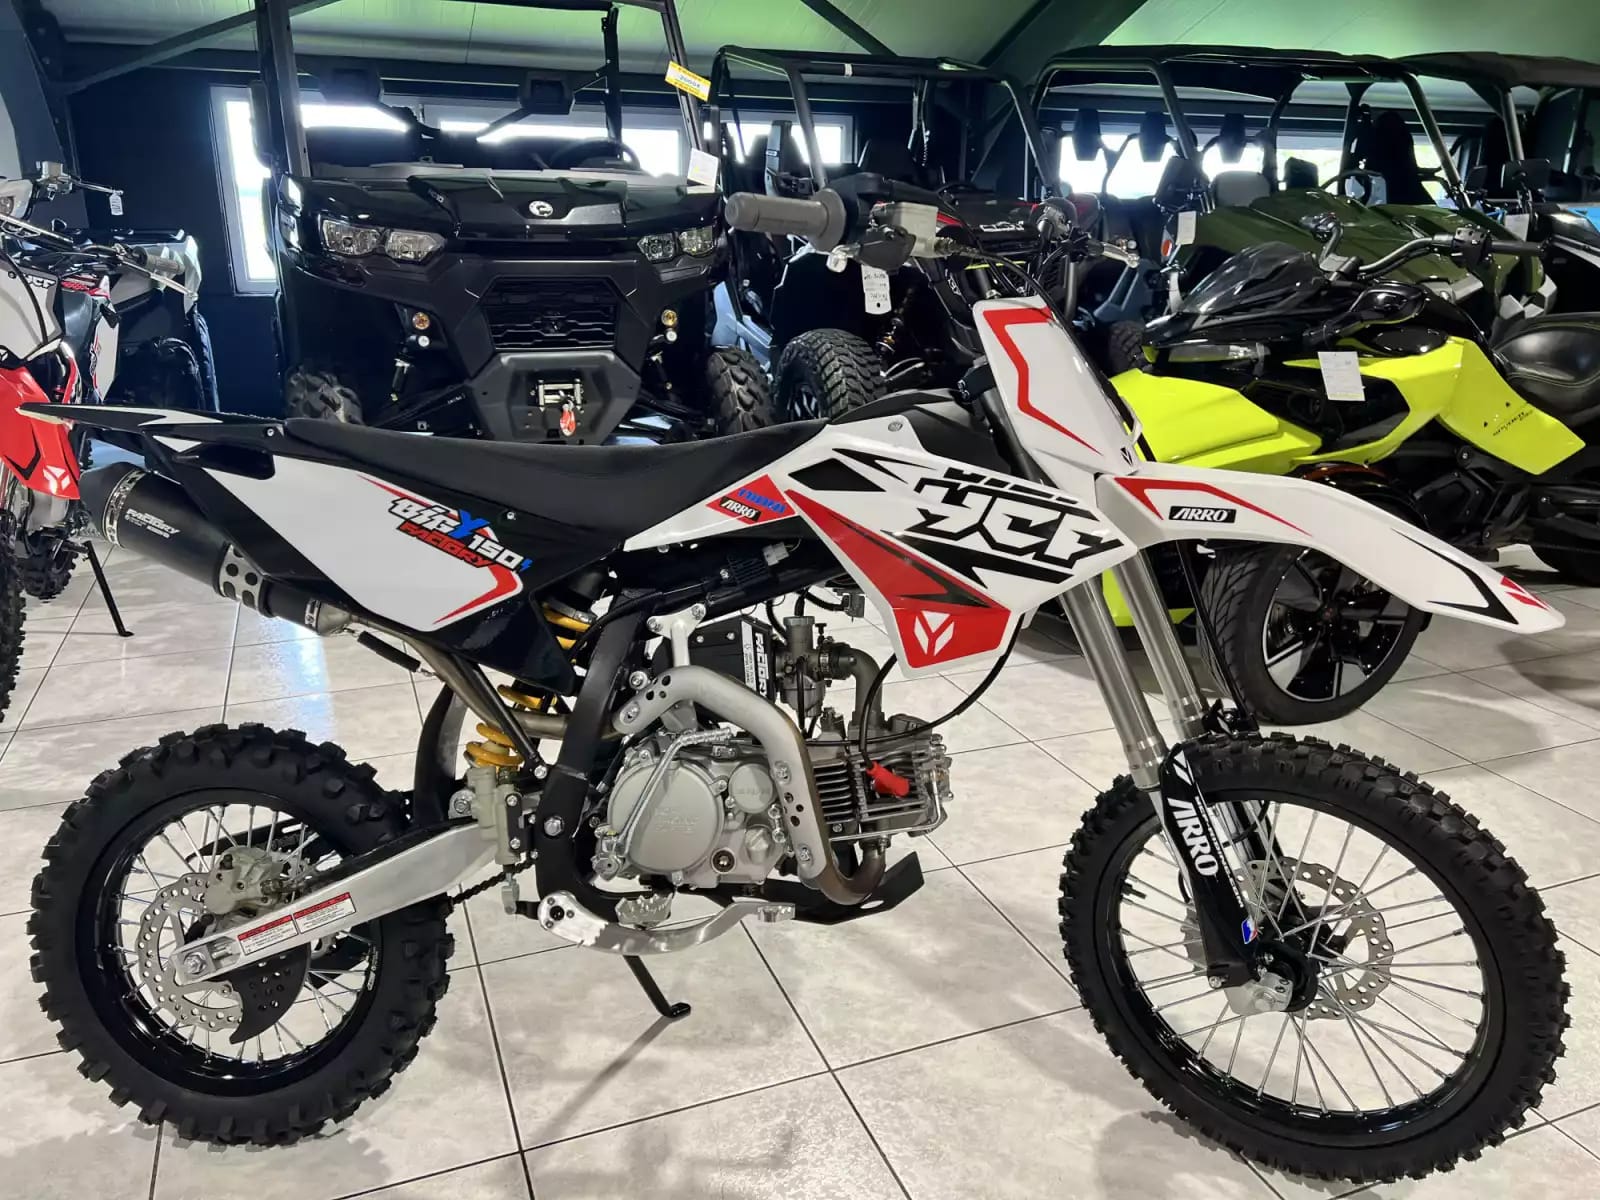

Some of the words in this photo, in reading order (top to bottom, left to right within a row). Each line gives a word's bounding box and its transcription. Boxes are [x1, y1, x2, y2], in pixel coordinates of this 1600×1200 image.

[720, 499, 757, 519] ARRO
[905, 477, 1124, 569] YCF
[1172, 507, 1229, 522] ARRO
[396, 520, 496, 568] FACTORY
[1167, 796, 1219, 877] ARRO
